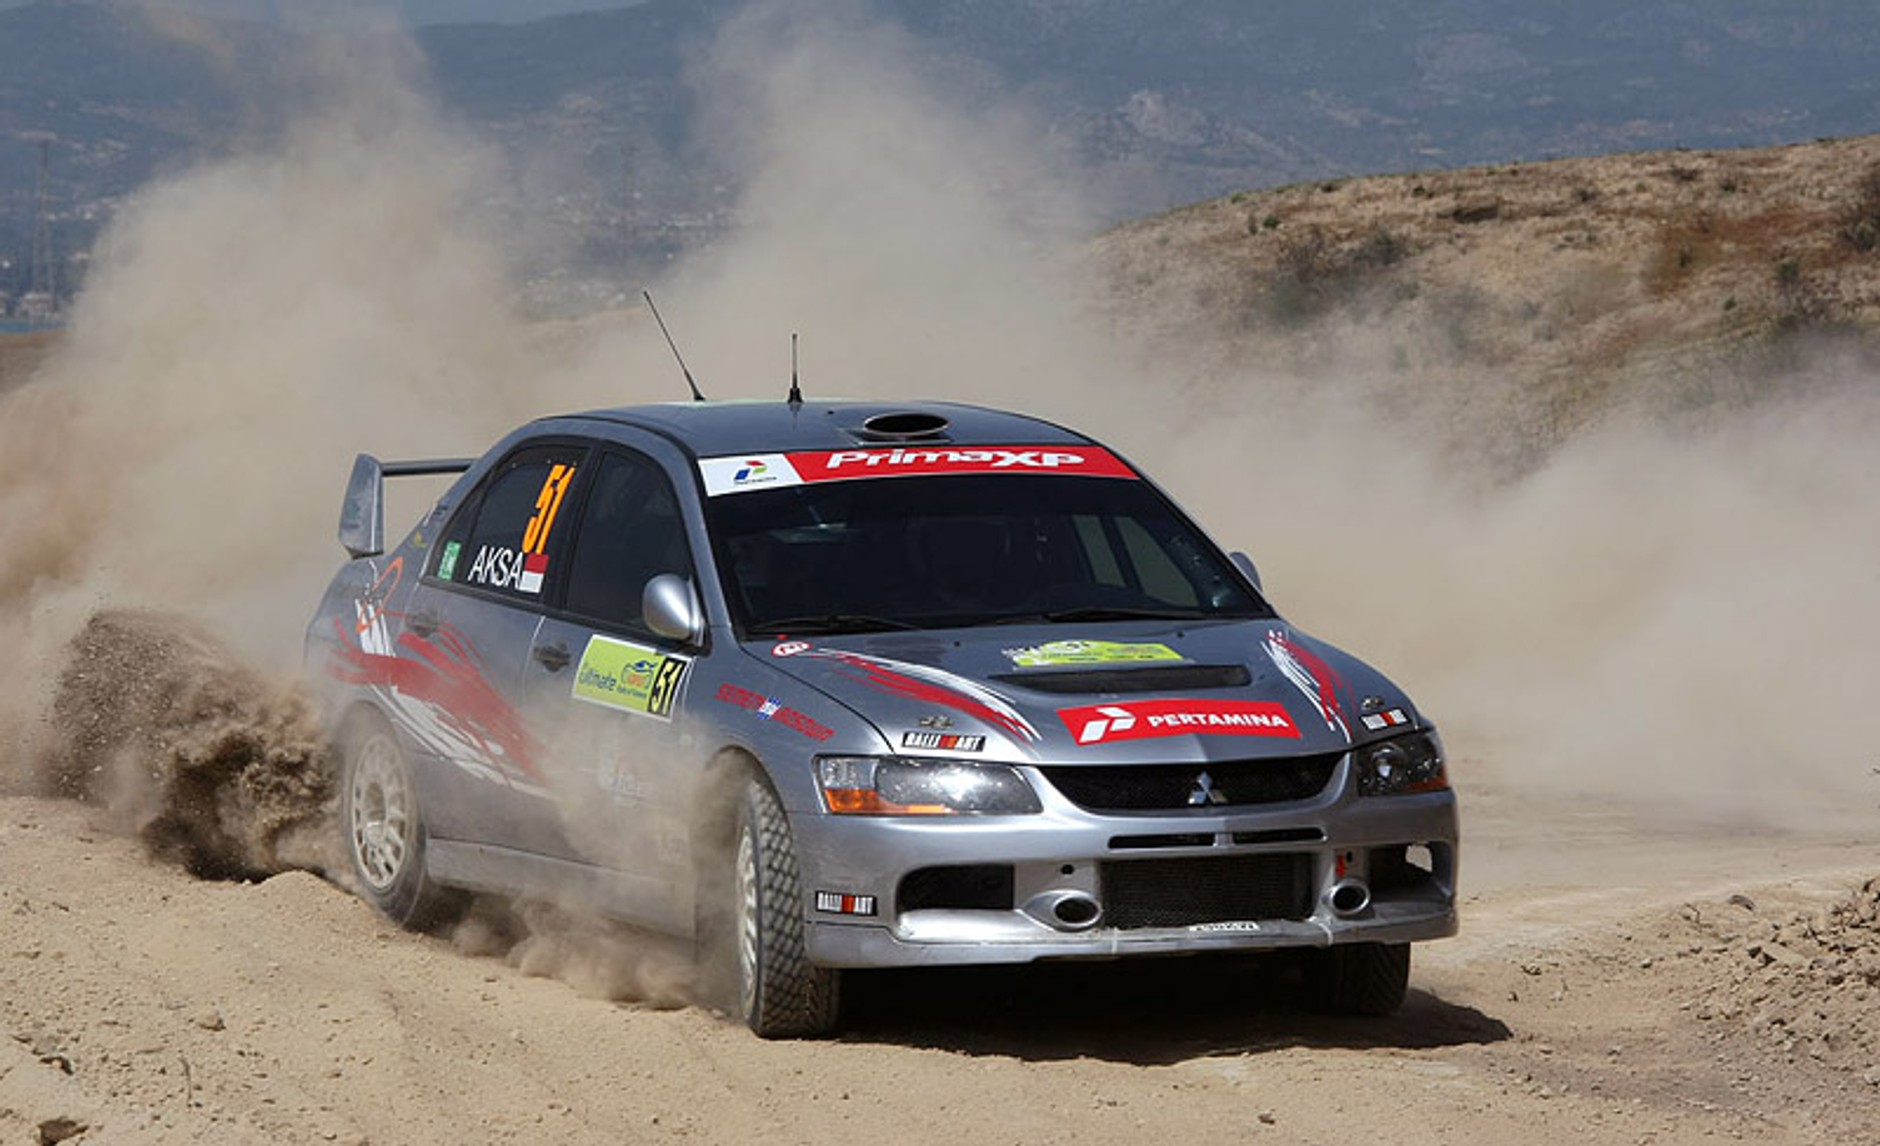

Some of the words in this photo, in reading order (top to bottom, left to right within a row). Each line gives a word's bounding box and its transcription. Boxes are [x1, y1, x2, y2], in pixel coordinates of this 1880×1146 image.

[827, 449, 1085, 468] PrimaXP
[522, 465, 575, 555] 51
[468, 545, 524, 589] AKSA
[651, 661, 683, 715] 51
[1147, 713, 1289, 728] PERTAMINA
